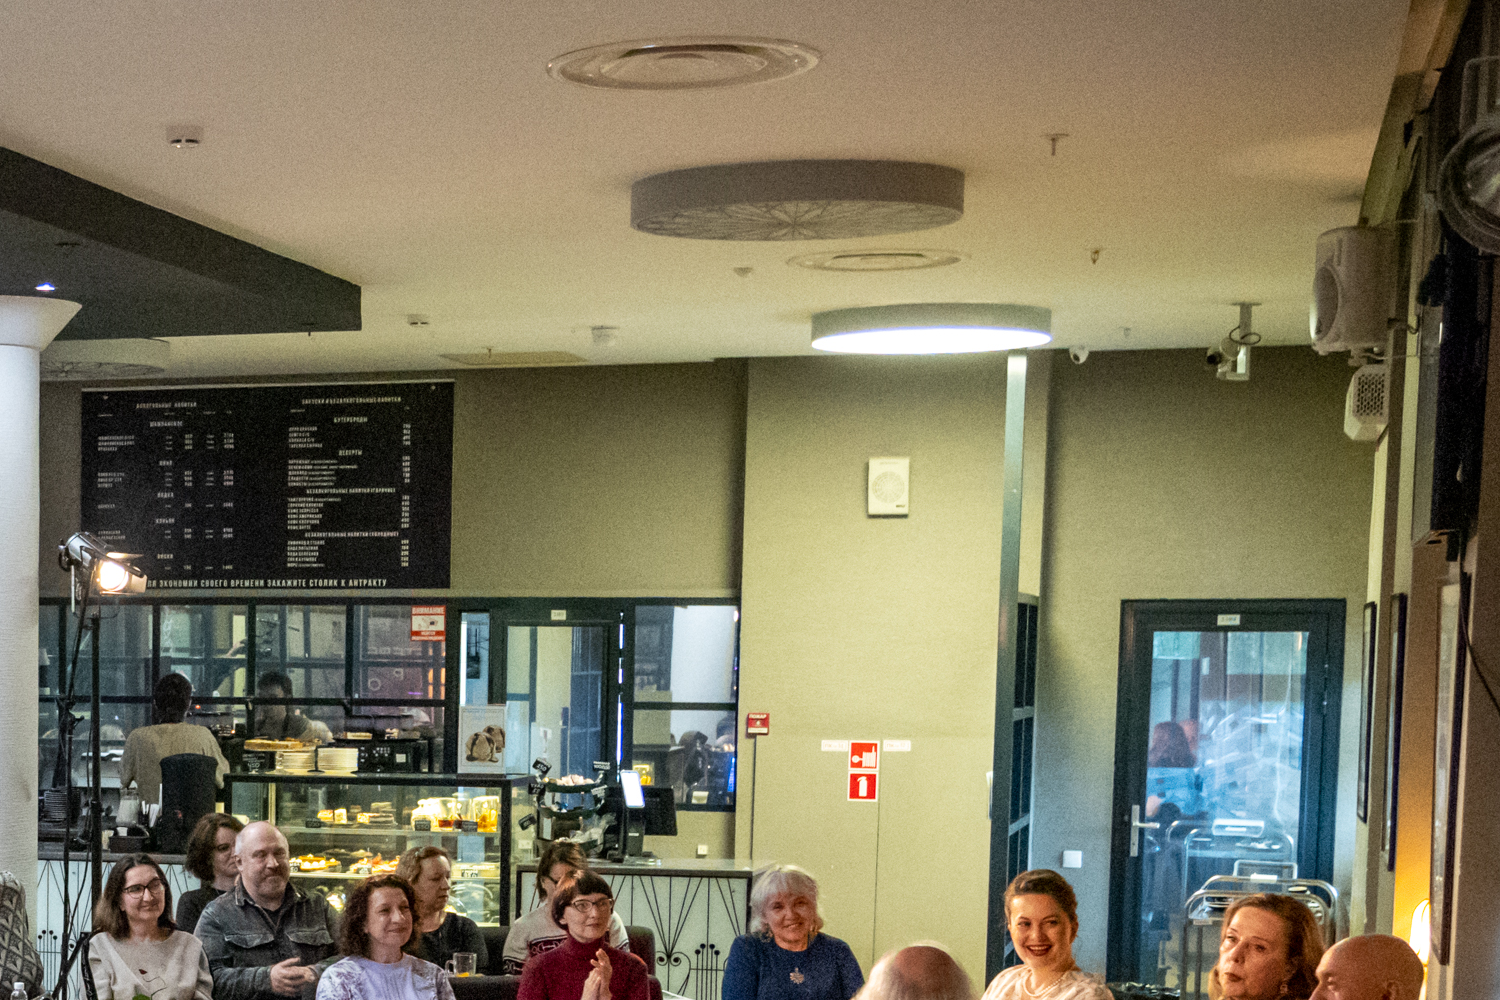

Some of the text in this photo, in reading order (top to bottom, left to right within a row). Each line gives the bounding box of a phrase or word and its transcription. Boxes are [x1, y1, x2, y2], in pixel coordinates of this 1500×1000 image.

[159, 579, 198, 588] ЭКОНОМИИ
[200, 579, 228, 588] СВОЕГО
[230, 578, 265, 587] ВРЕМЕНИ
[266, 578, 307, 588] ЗАКАЖИТЕ
[309, 578, 338, 587] СТОЛИК
[340, 578, 346, 587] К
[348, 578, 387, 587] АНТРАКТУ
